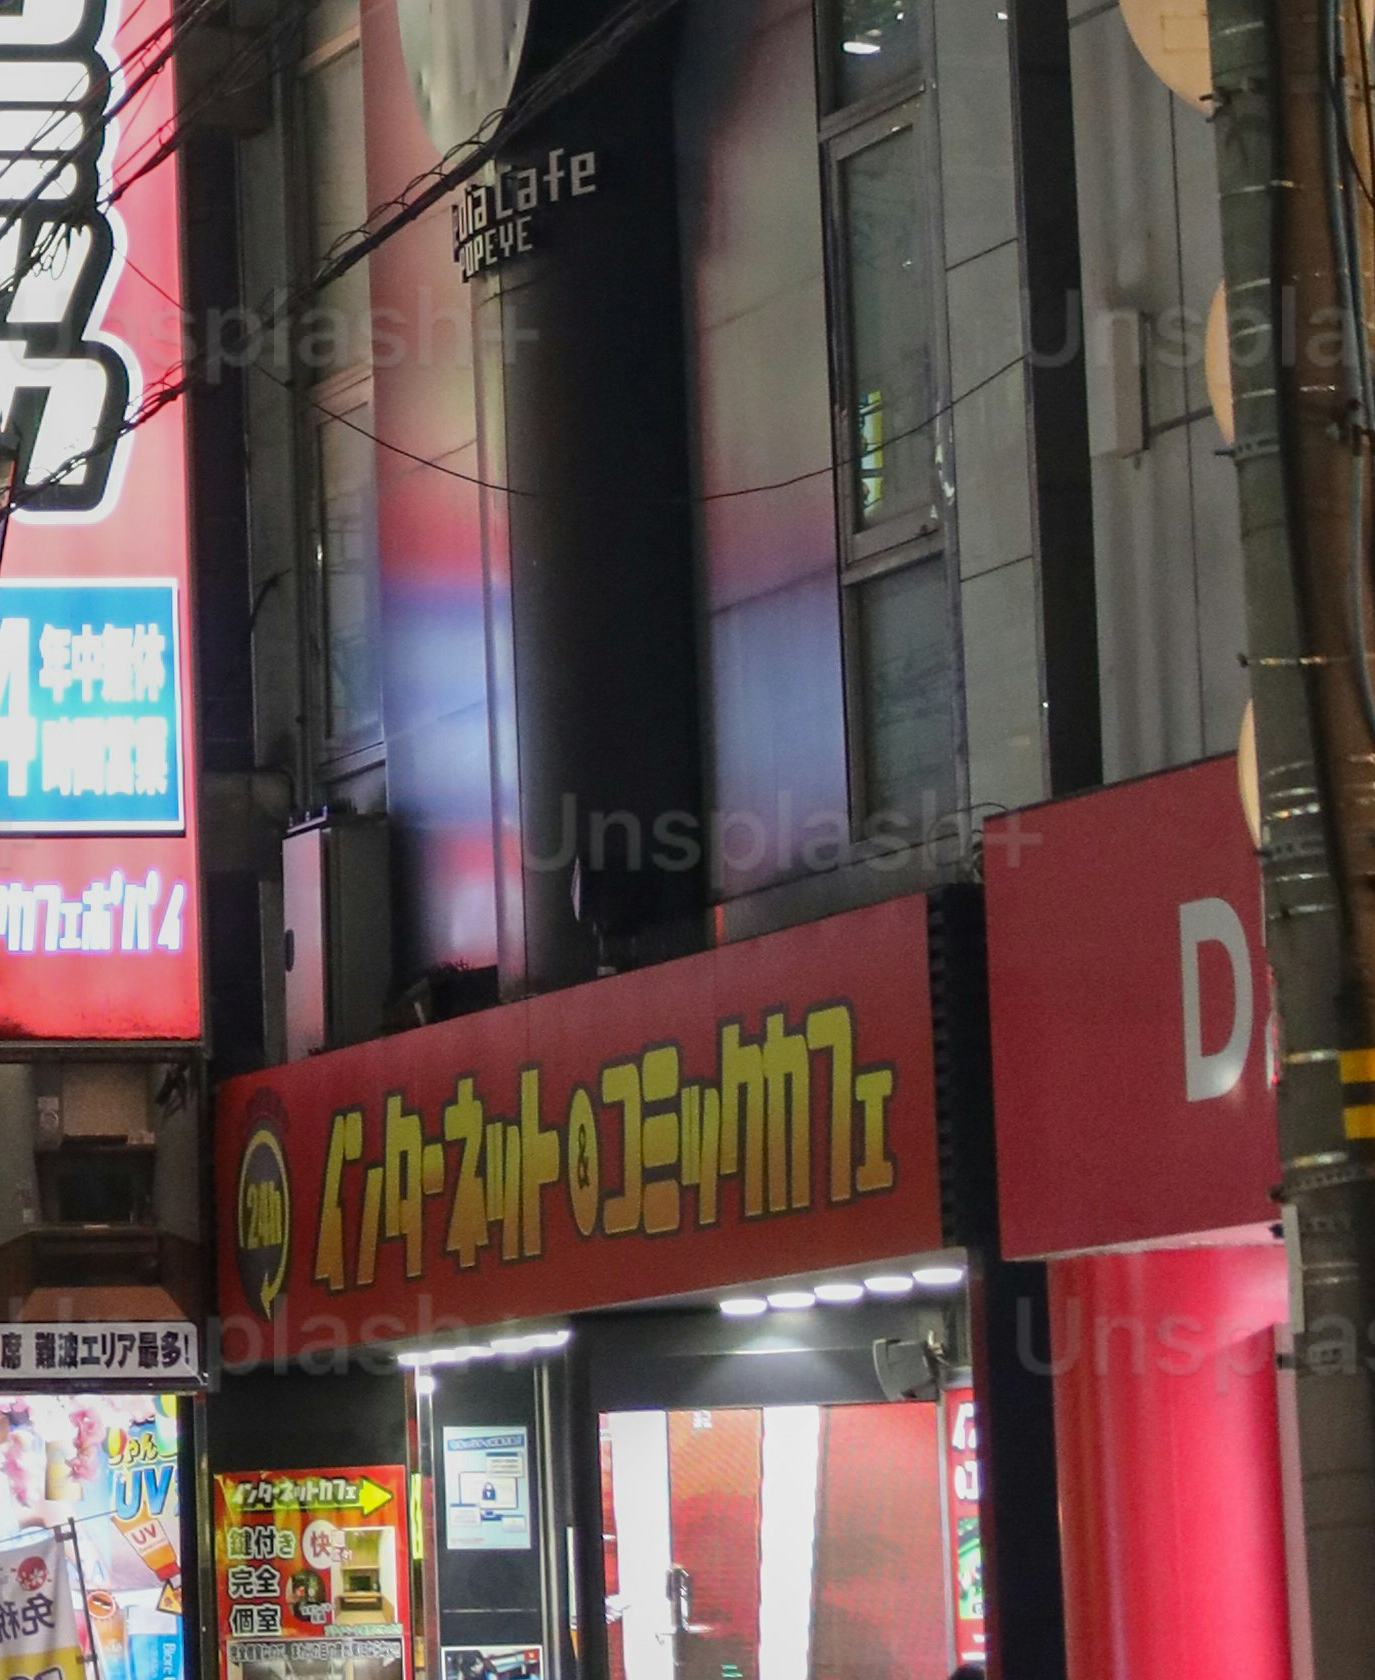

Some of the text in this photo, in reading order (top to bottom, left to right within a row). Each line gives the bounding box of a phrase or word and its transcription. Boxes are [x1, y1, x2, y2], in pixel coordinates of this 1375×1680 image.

[494, 147, 597, 220] Cafe
[312, 1002, 896, 1292] インターネット&コミックカフェ
[0, 1333, 23, 1370] 席
[34, 1330, 191, 1371] 難波エリア最多!
[112, 1466, 176, 1522] UV
[227, 1526, 297, 1559] 鍵付き
[228, 1565, 281, 1600] 完全
[230, 1603, 282, 1638] 個室
